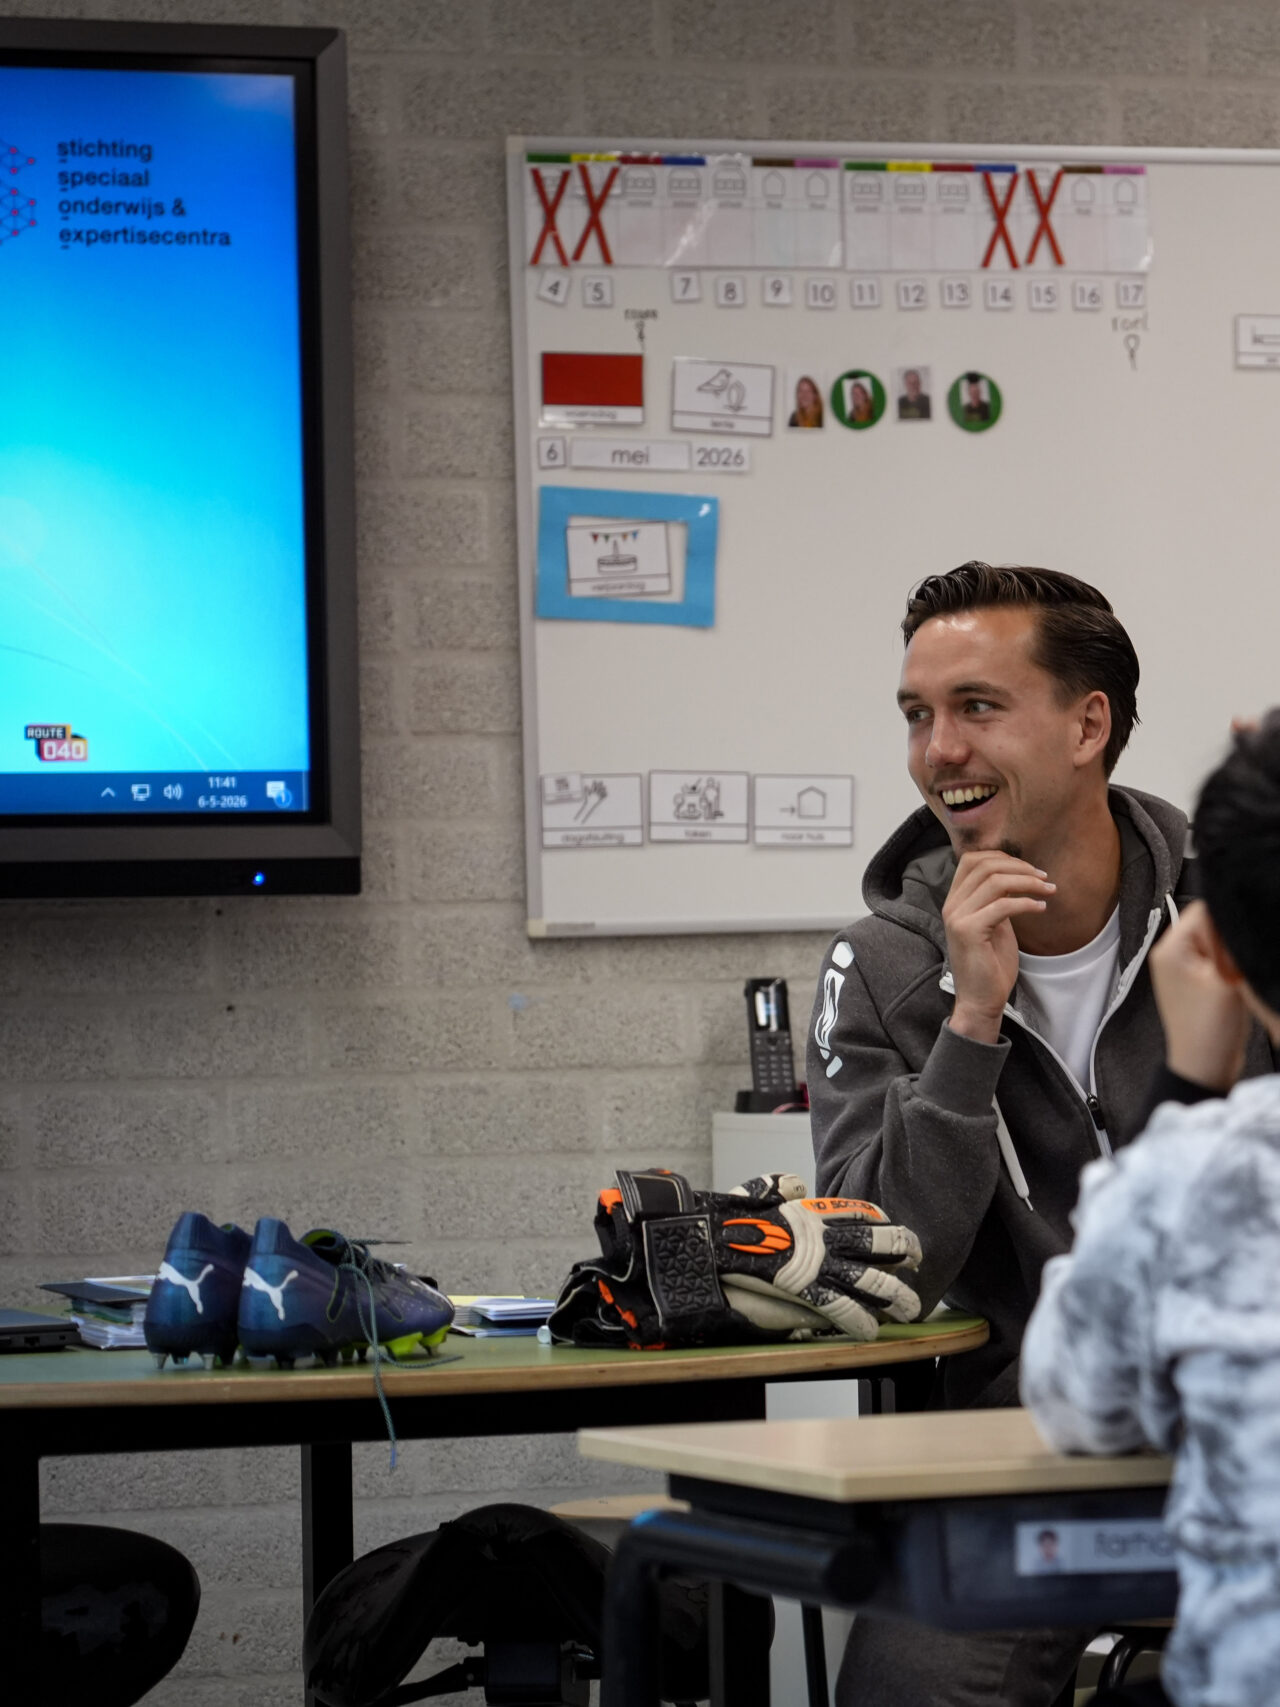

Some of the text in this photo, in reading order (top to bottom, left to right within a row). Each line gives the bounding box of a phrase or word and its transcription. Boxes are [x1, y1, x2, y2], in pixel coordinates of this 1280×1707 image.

[57, 138, 153, 162] stichting
[57, 168, 150, 187] speciaal
[58, 197, 187, 219] onderwijs &
[59, 226, 232, 247] expertisecentra
[549, 278, 1144, 305] 4 5 7 8 9 10 11 12 13 14 15 16 17
[546, 443, 745, 467] 6 mei 2026
[26, 727, 64, 739] ROUTE
[43, 741, 86, 760] 040
[208, 776, 236, 789] 11:41
[198, 795, 248, 808] 6-5-2026
